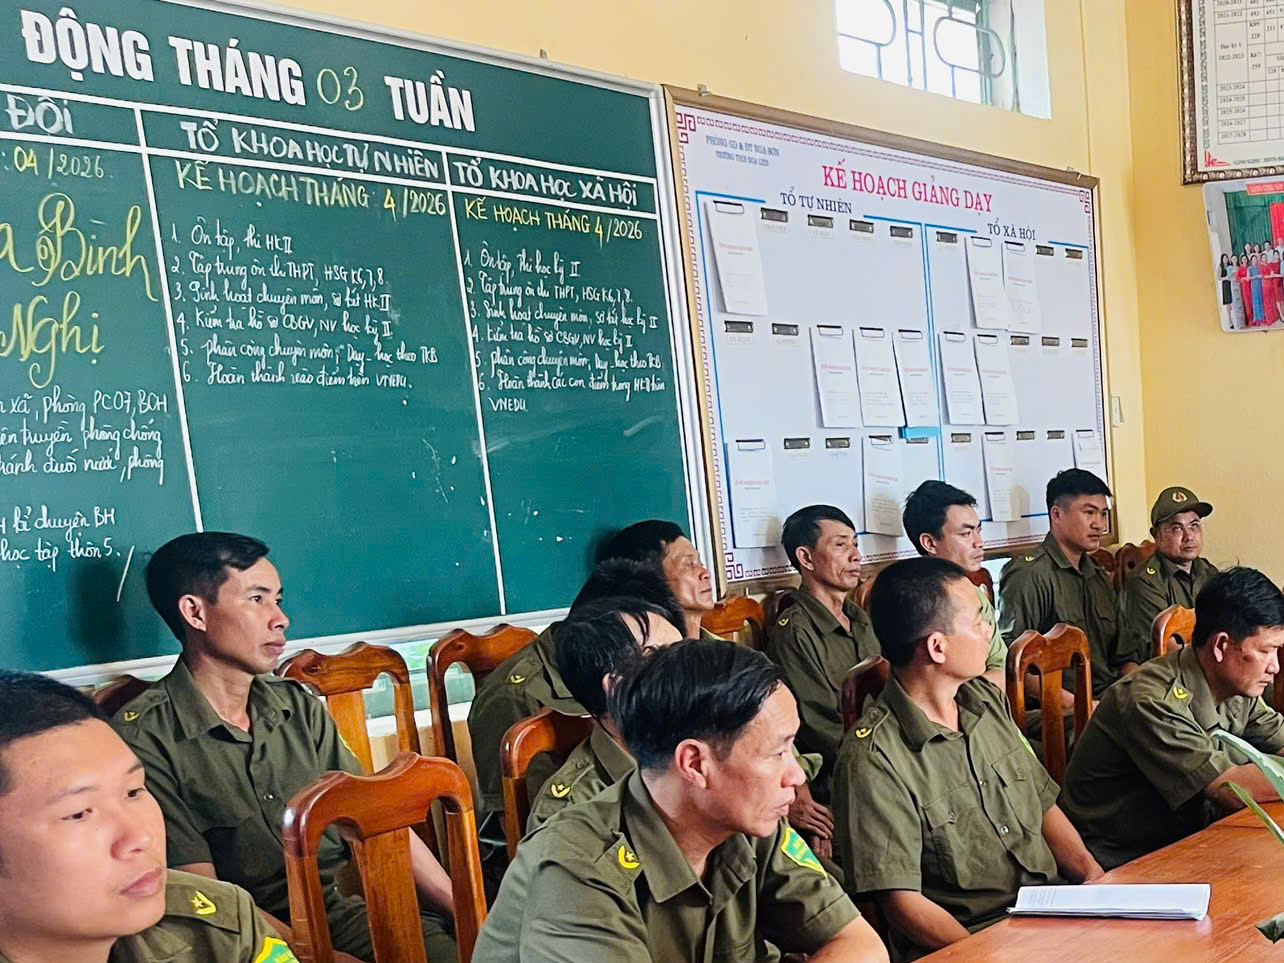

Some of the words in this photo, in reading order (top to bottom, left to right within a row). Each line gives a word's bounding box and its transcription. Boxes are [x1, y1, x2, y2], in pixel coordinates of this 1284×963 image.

[20, 7, 154, 81] ĐỘNG
[168, 38, 306, 106] THÁNG
[317, 66, 364, 111] 03
[384, 70, 475, 132] TUẦN
[232, 127, 304, 160] KHOA
[374, 149, 438, 178] NHIÊN
[489, 166, 538, 192] KHOA
[579, 176, 605, 200] XÃ
[780, 186, 796, 206] TỔ
[822, 158, 847, 190] KẾ
[851, 170, 908, 201] HOẠCH
[912, 175, 960, 208] GIẢNG
[964, 190, 992, 216] DẠY
[545, 208, 590, 234] THÁNG
[988, 217, 1000, 236] TỔ
[1019, 227, 1036, 242] HỘI
